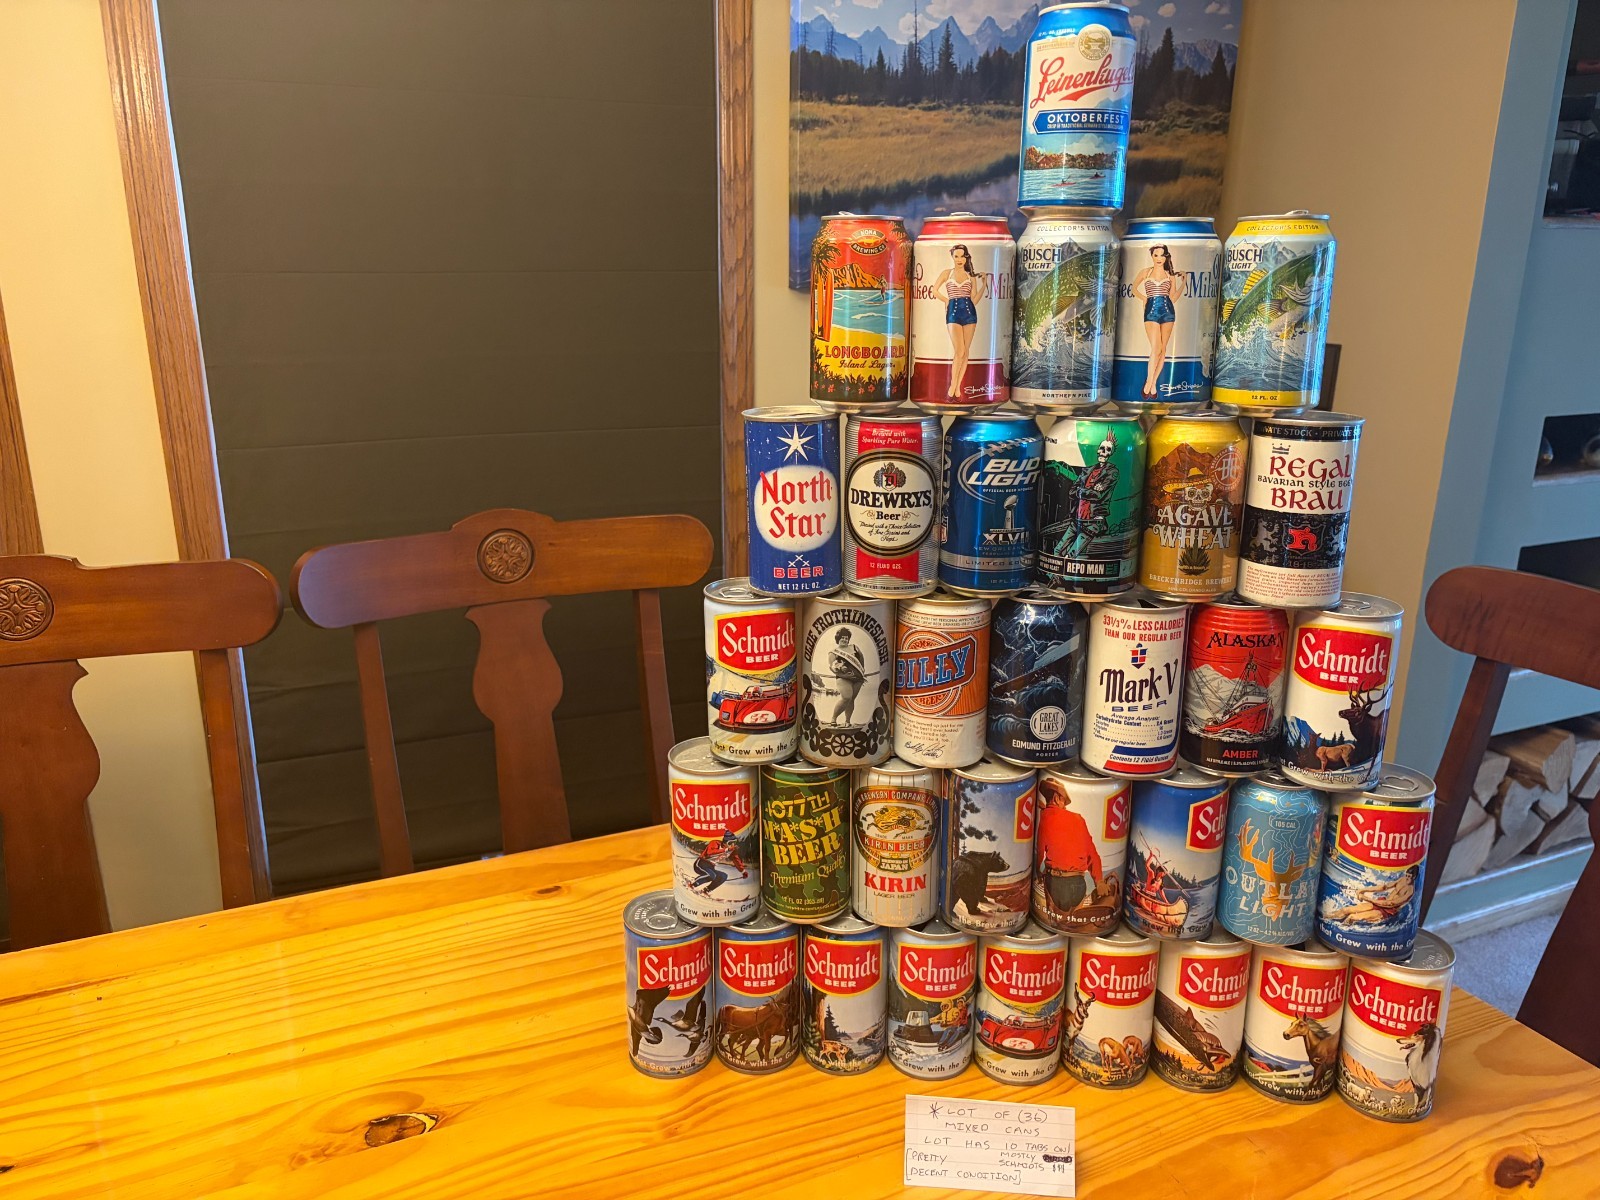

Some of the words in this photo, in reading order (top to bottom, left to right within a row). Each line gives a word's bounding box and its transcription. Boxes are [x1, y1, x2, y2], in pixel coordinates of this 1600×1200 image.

[1047, 113, 1124, 124] OKTOBERFEST
[853, 243, 878, 253] BREWING
[1022, 248, 1062, 262] BUSCH
[1227, 249, 1262, 263] BUSCH
[1028, 262, 1052, 270] LIGHT
[1231, 262, 1253, 270] LIGHT
[825, 345, 904, 359] LONGBOARD
[838, 360, 866, 369] Island
[1283, 428, 1312, 437] STOCK
[1322, 430, 1352, 438] PRIVATE
[862, 436, 886, 445] Sparkling
[983, 457, 1040, 472] BUD
[967, 470, 1041, 486] LIGHT
[1308, 479, 1336, 490] style
[760, 470, 833, 505] North
[851, 488, 931, 508] DREWRYS
[1271, 487, 1343, 510] BRAU
[769, 506, 826, 538] Star
[876, 511, 900, 520] Beer
[1157, 504, 1233, 527] AGAVE
[1153, 525, 1234, 549] WHEAT
[774, 566, 824, 578] BEER
[1067, 562, 1084, 574] REPO
[1087, 564, 1104, 575] MAN
[1149, 574, 1202, 585] BRECKENRIDGE
[778, 583, 790, 591] NET
[1133, 621, 1153, 631] LESS
[1154, 618, 1185, 631] CALORIES
[722, 620, 795, 657] Schmidt
[804, 631, 818, 662] OLDE
[812, 609, 890, 666] FROTHINGSLOSH
[1104, 628, 1120, 639] THAN
[1122, 631, 1136, 641] OUR
[1139, 632, 1167, 642] REGULAR
[1170, 631, 1182, 640] BEER
[1206, 631, 1285, 649] ALASKAN
[745, 653, 779, 663] BEER
[1298, 632, 1387, 674] Schmidt
[896, 644, 971, 688] BILLY
[1099, 667, 1162, 704] Mark
[1163, 658, 1179, 695] V
[1319, 672, 1359, 684] BEER
[1112, 700, 1167, 712] BEER
[1040, 712, 1059, 722] GREAT
[1096, 713, 1122, 724] Carbohydrate
[1040, 722, 1059, 732] LAKES
[729, 745, 750, 755] Grew
[755, 746, 773, 755] with
[777, 742, 788, 751] the
[1012, 739, 1040, 750] EDMUND
[1043, 737, 1075, 750] FITZGERALD
[1110, 754, 1132, 762] Contents
[1223, 750, 1258, 758] AMBER
[1287, 761, 1309, 777] Grew
[1313, 771, 1334, 782] with
[891, 791, 925, 801] COMPANY
[675, 787, 748, 821] Schmidt
[693, 822, 727, 831] BEER
[1343, 811, 1430, 851] Schmidt
[772, 831, 841, 865] BEER
[865, 836, 894, 851] KIRIN
[899, 840, 925, 851] BEER
[1369, 850, 1408, 860] BEER
[769, 872, 814, 888] Premium
[817, 851, 846, 877] Quality
[880, 862, 908, 870] JAPAN
[864, 871, 927, 893] KIRIN
[680, 903, 698, 917] Grew
[702, 908, 720, 918] with
[724, 906, 737, 916] the
[1239, 895, 1307, 919] LIGHT
[958, 915, 972, 926] The
[975, 919, 997, 928] Brew
[1042, 906, 1063, 919] Brew
[1067, 915, 1087, 923] that
[1090, 914, 1111, 923] Grew
[1319, 922, 1332, 938] that
[1335, 934, 1361, 948] Grew
[1366, 940, 1387, 952] with
[1391, 940, 1403, 951] the
[643, 945, 711, 984] Schmidt
[723, 947, 794, 979] Schmidt
[807, 943, 878, 979] Schmidt
[903, 949, 975, 983] Schmidt
[988, 953, 1063, 989] Schmidt
[1083, 958, 1156, 993] Schmidt
[1185, 959, 1249, 993] Schmid
[668, 978, 698, 991] BEER
[743, 979, 776, 987] BEER
[824, 978, 857, 987] BEER
[925, 984, 957, 992] BEER
[1264, 966, 1344, 1004] Schmidt
[1009, 988, 1043, 997] BEER
[1106, 991, 1140, 999] BEER
[1210, 992, 1239, 1001] BEER
[1352, 974, 1436, 1024] Schmidt
[1288, 1002, 1324, 1014] BEER
[1369, 1013, 1408, 1031] BEER
[650, 1063, 670, 1071] Grew
[726, 1053, 746, 1066] Grew
[750, 1058, 768, 1067] with
[771, 1056, 783, 1065] the
[828, 1057, 846, 1068] with
[850, 1057, 861, 1066] the
[902, 1060, 924, 1071] Grew
[928, 1063, 945, 1073] with
[949, 1060, 959, 1071] the
[986, 1061, 1007, 1074] Grew
[1011, 1068, 1029, 1077] with
[1033, 1067, 1044, 1077] the
[1258, 1077, 1280, 1092] Grew
[1284, 1085, 1304, 1096] with
[1363, 1100, 1384, 1111] with
[1388, 1106, 1403, 1114] the
[947, 1108, 978, 1117] LOT
[994, 1110, 1010, 1119] OF
[1018, 1108, 1048, 1123] (36)
[945, 1122, 989, 1133] MIXED
[1005, 1126, 1040, 1136] CANS
[924, 1135, 952, 1145] LOT
[965, 1140, 990, 1150] HAS
[1005, 1142, 1017, 1150] 10
[1025, 1143, 1048, 1151] TABS
[1000, 1151, 1036, 1161] MOSTLY
[910, 1167, 948, 1177] DECENT
